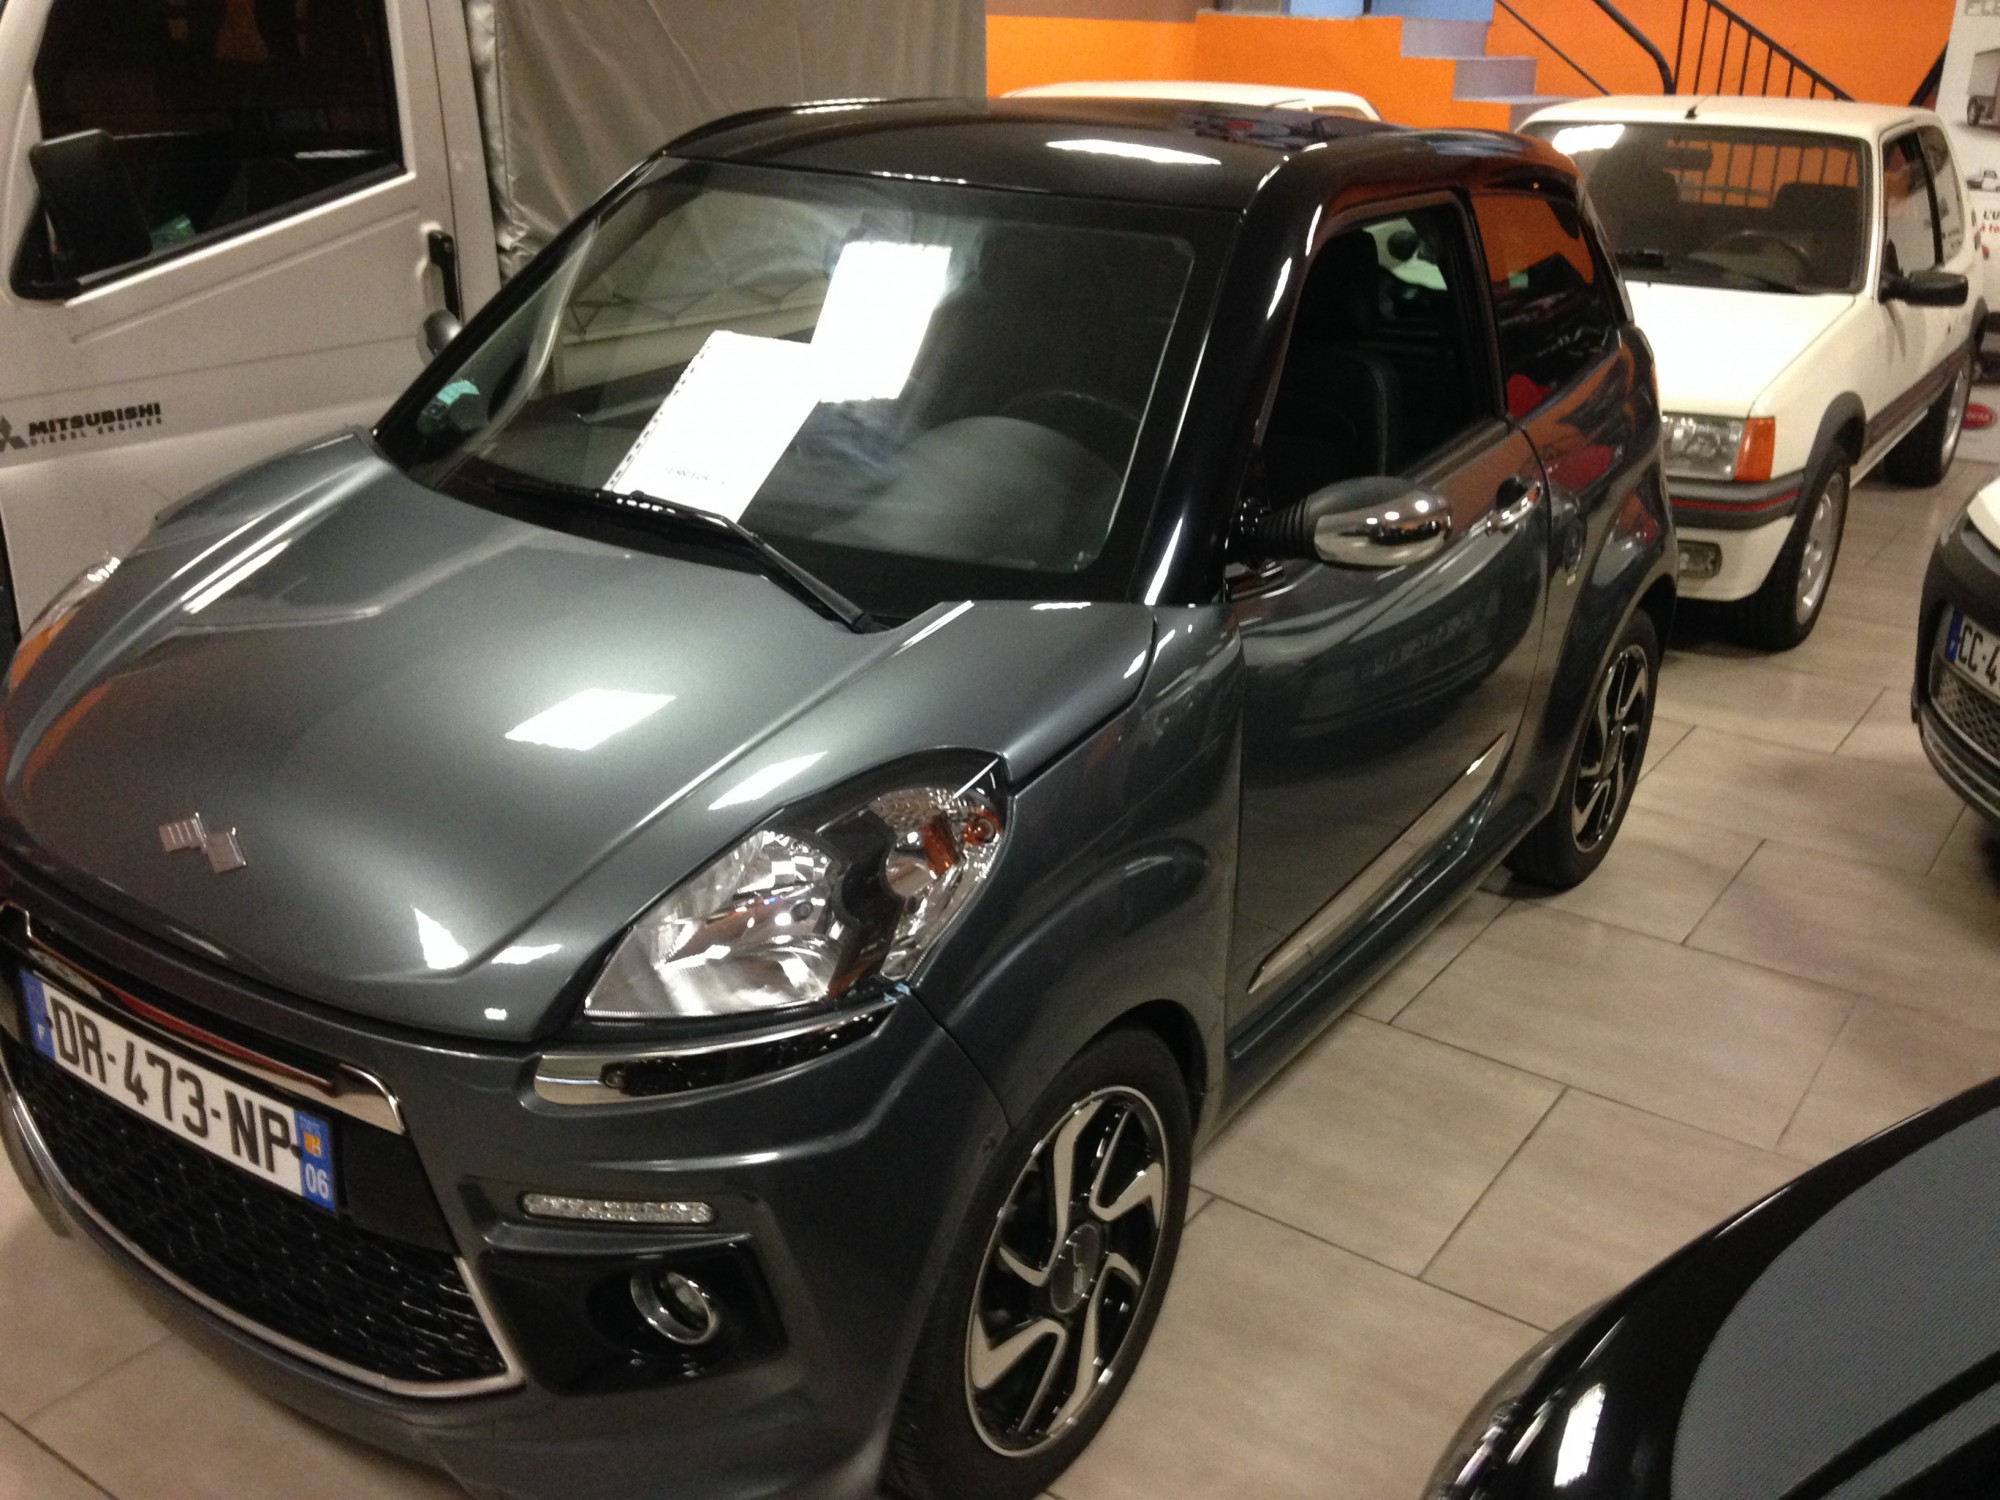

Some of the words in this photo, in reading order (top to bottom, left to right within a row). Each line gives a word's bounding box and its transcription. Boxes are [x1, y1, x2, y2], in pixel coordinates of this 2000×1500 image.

[29, 403, 161, 436] MITSUBISHI
[31, 429, 87, 446] DIESEL
[97, 417, 162, 435] ENGINES
[37, 1023, 46, 1041] F
[51, 997, 291, 1173] DR-473-NP
[305, 1162, 329, 1199] 06
